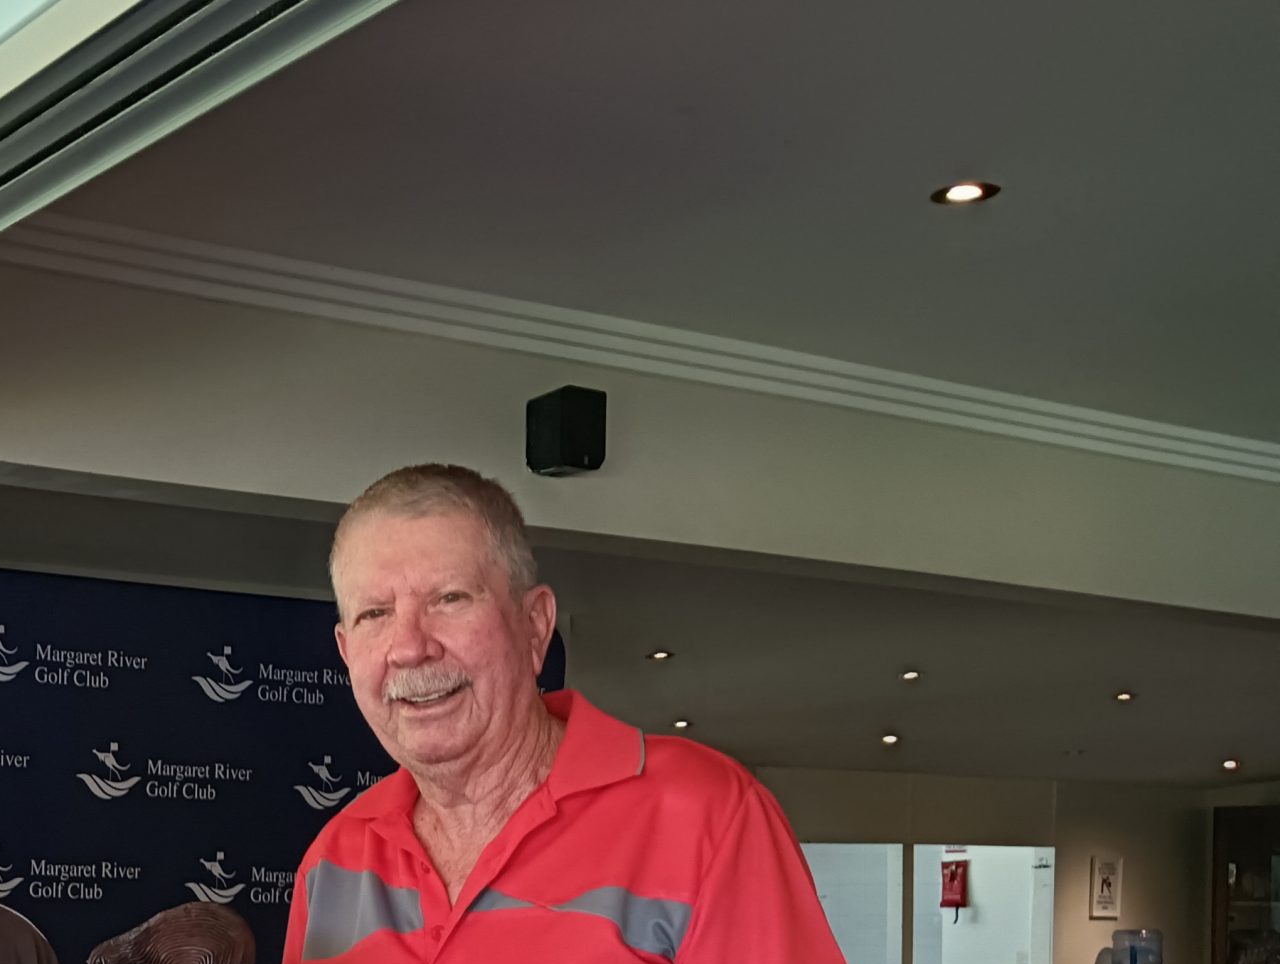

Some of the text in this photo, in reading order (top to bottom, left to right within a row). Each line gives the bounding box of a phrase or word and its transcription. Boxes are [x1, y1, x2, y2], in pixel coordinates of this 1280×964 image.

[36, 643, 148, 670] Margaret River
[34, 667, 109, 689] Golf Club
[258, 663, 352, 686] Margaret Rive
[257, 685, 325, 705] Golf Club
[146, 759, 253, 781] Margaret River
[145, 781, 216, 800] Golf Club
[30, 859, 141, 881] Margaret River
[251, 866, 297, 887] Marga
[29, 881, 103, 900] Golf Club
[250, 887, 282, 904] Golf
